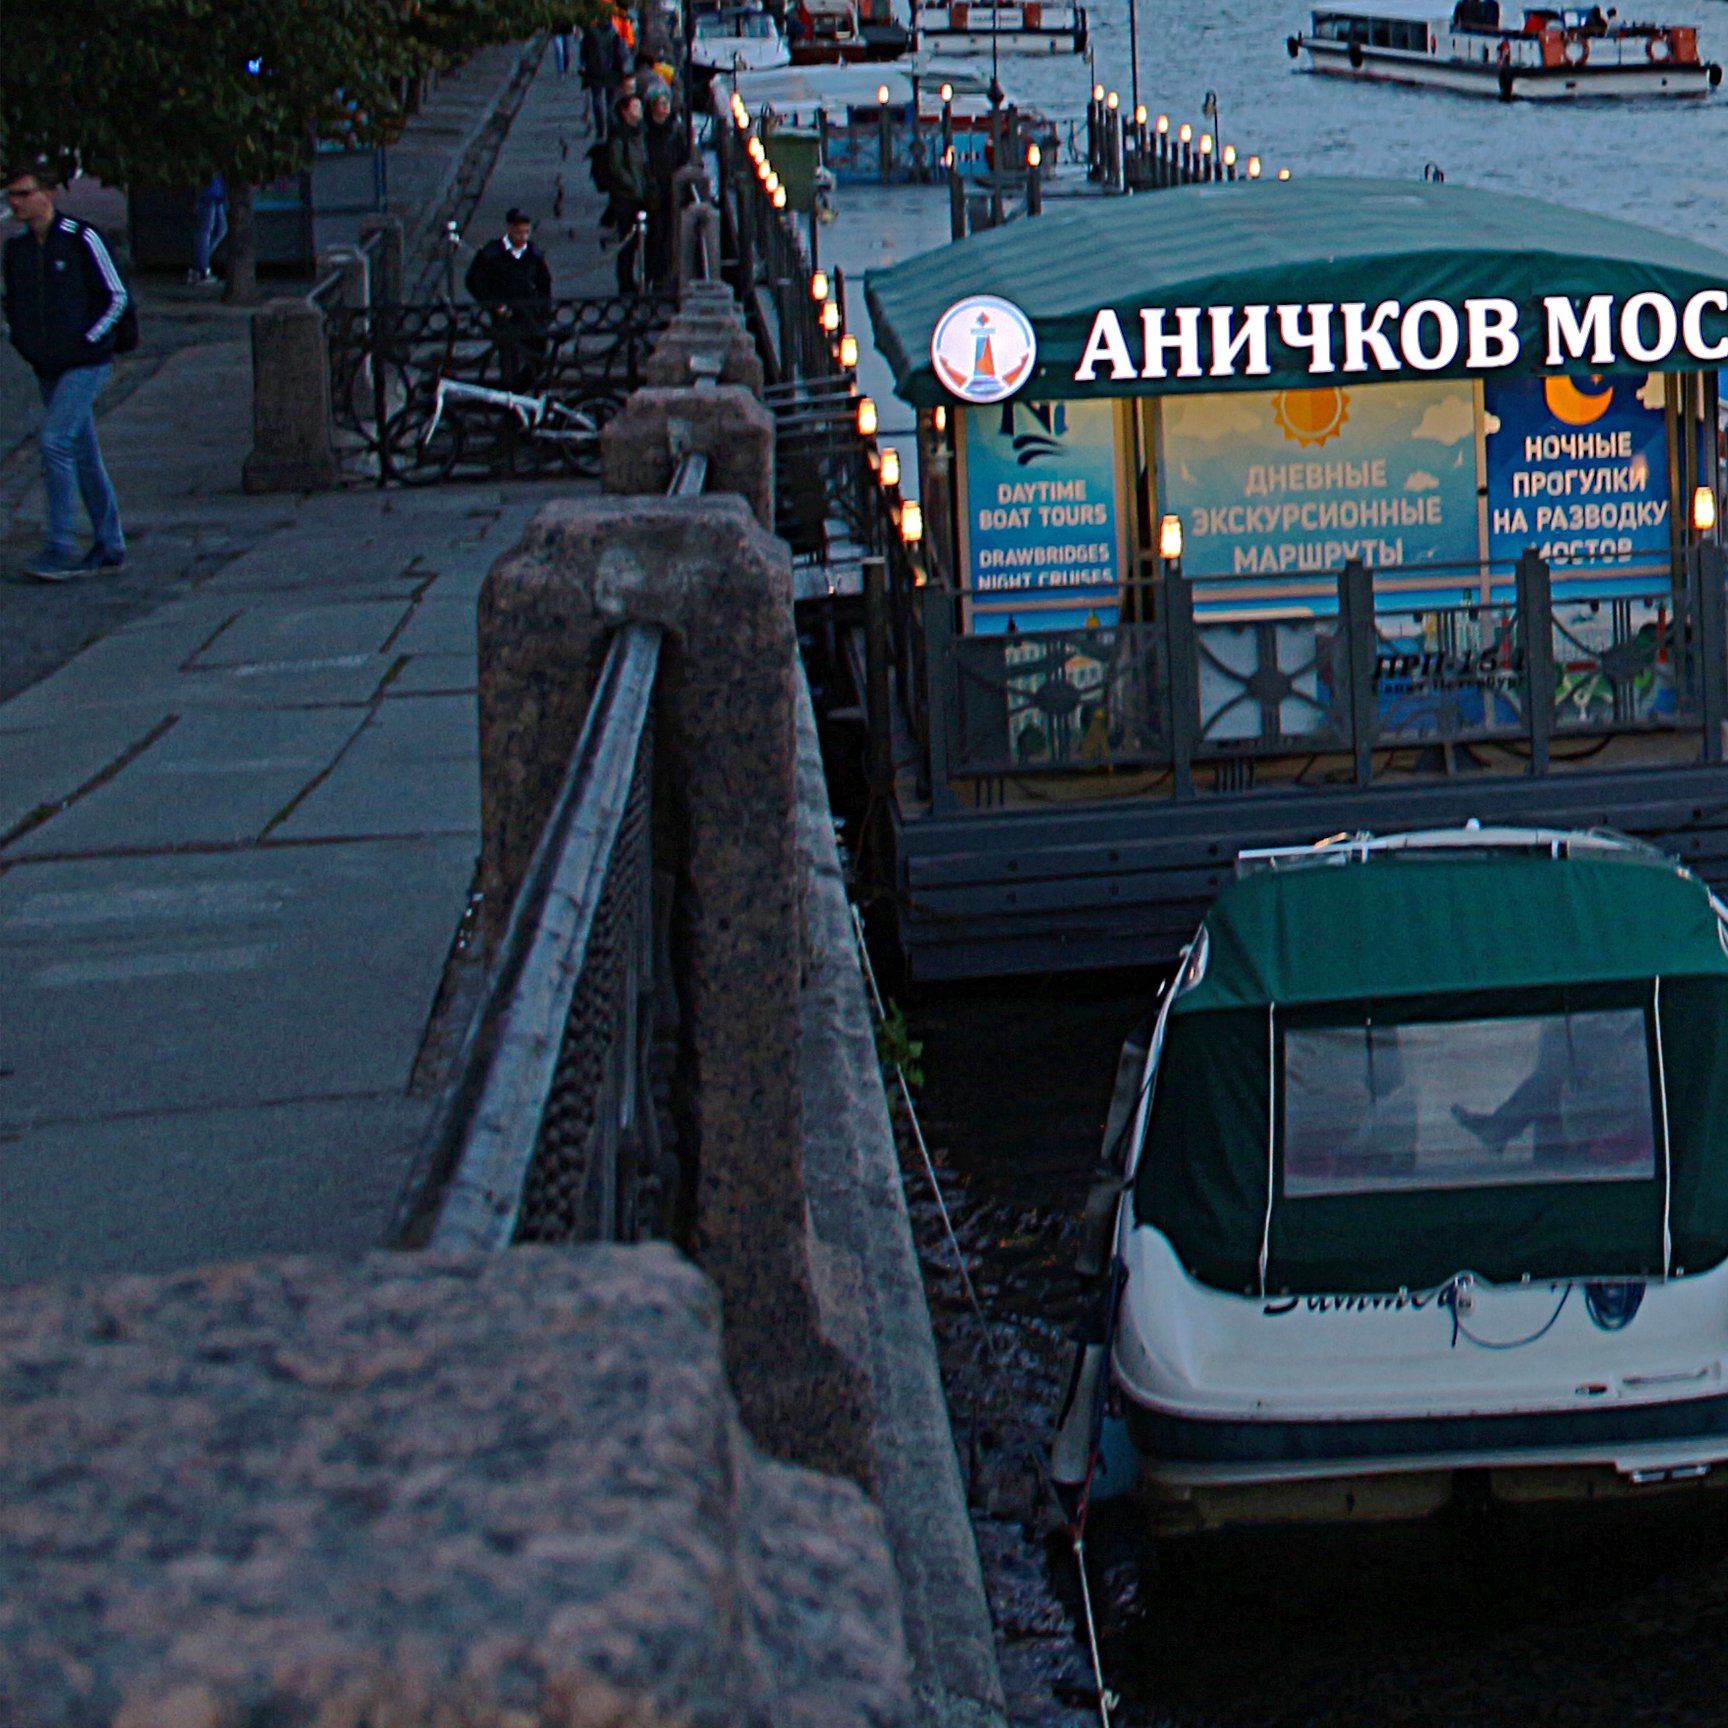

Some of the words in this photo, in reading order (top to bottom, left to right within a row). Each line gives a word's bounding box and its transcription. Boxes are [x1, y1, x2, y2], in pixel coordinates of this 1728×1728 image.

[1074, 298, 1521, 382] АНИЧКОВ
[1525, 431, 1633, 462] НОЧНЫЕ
[997, 479, 1087, 505] DAYTIME
[1244, 458, 1387, 497] ДНЕВНЫЕ
[1512, 466, 1648, 499] ПРОГУЛКИ
[978, 507, 1032, 531] BOAT
[1038, 503, 1107, 528] TOURS
[1191, 495, 1443, 537] ЭКСКУРСИОННЫЕ
[1493, 507, 1529, 535] НА
[1536, 499, 1669, 533] РАЗВОДКУ
[979, 543, 1110, 569] DRAWBRIDGES
[1233, 537, 1404, 573] МАРШРУТЫ
[977, 572, 1033, 591] NIGHT
